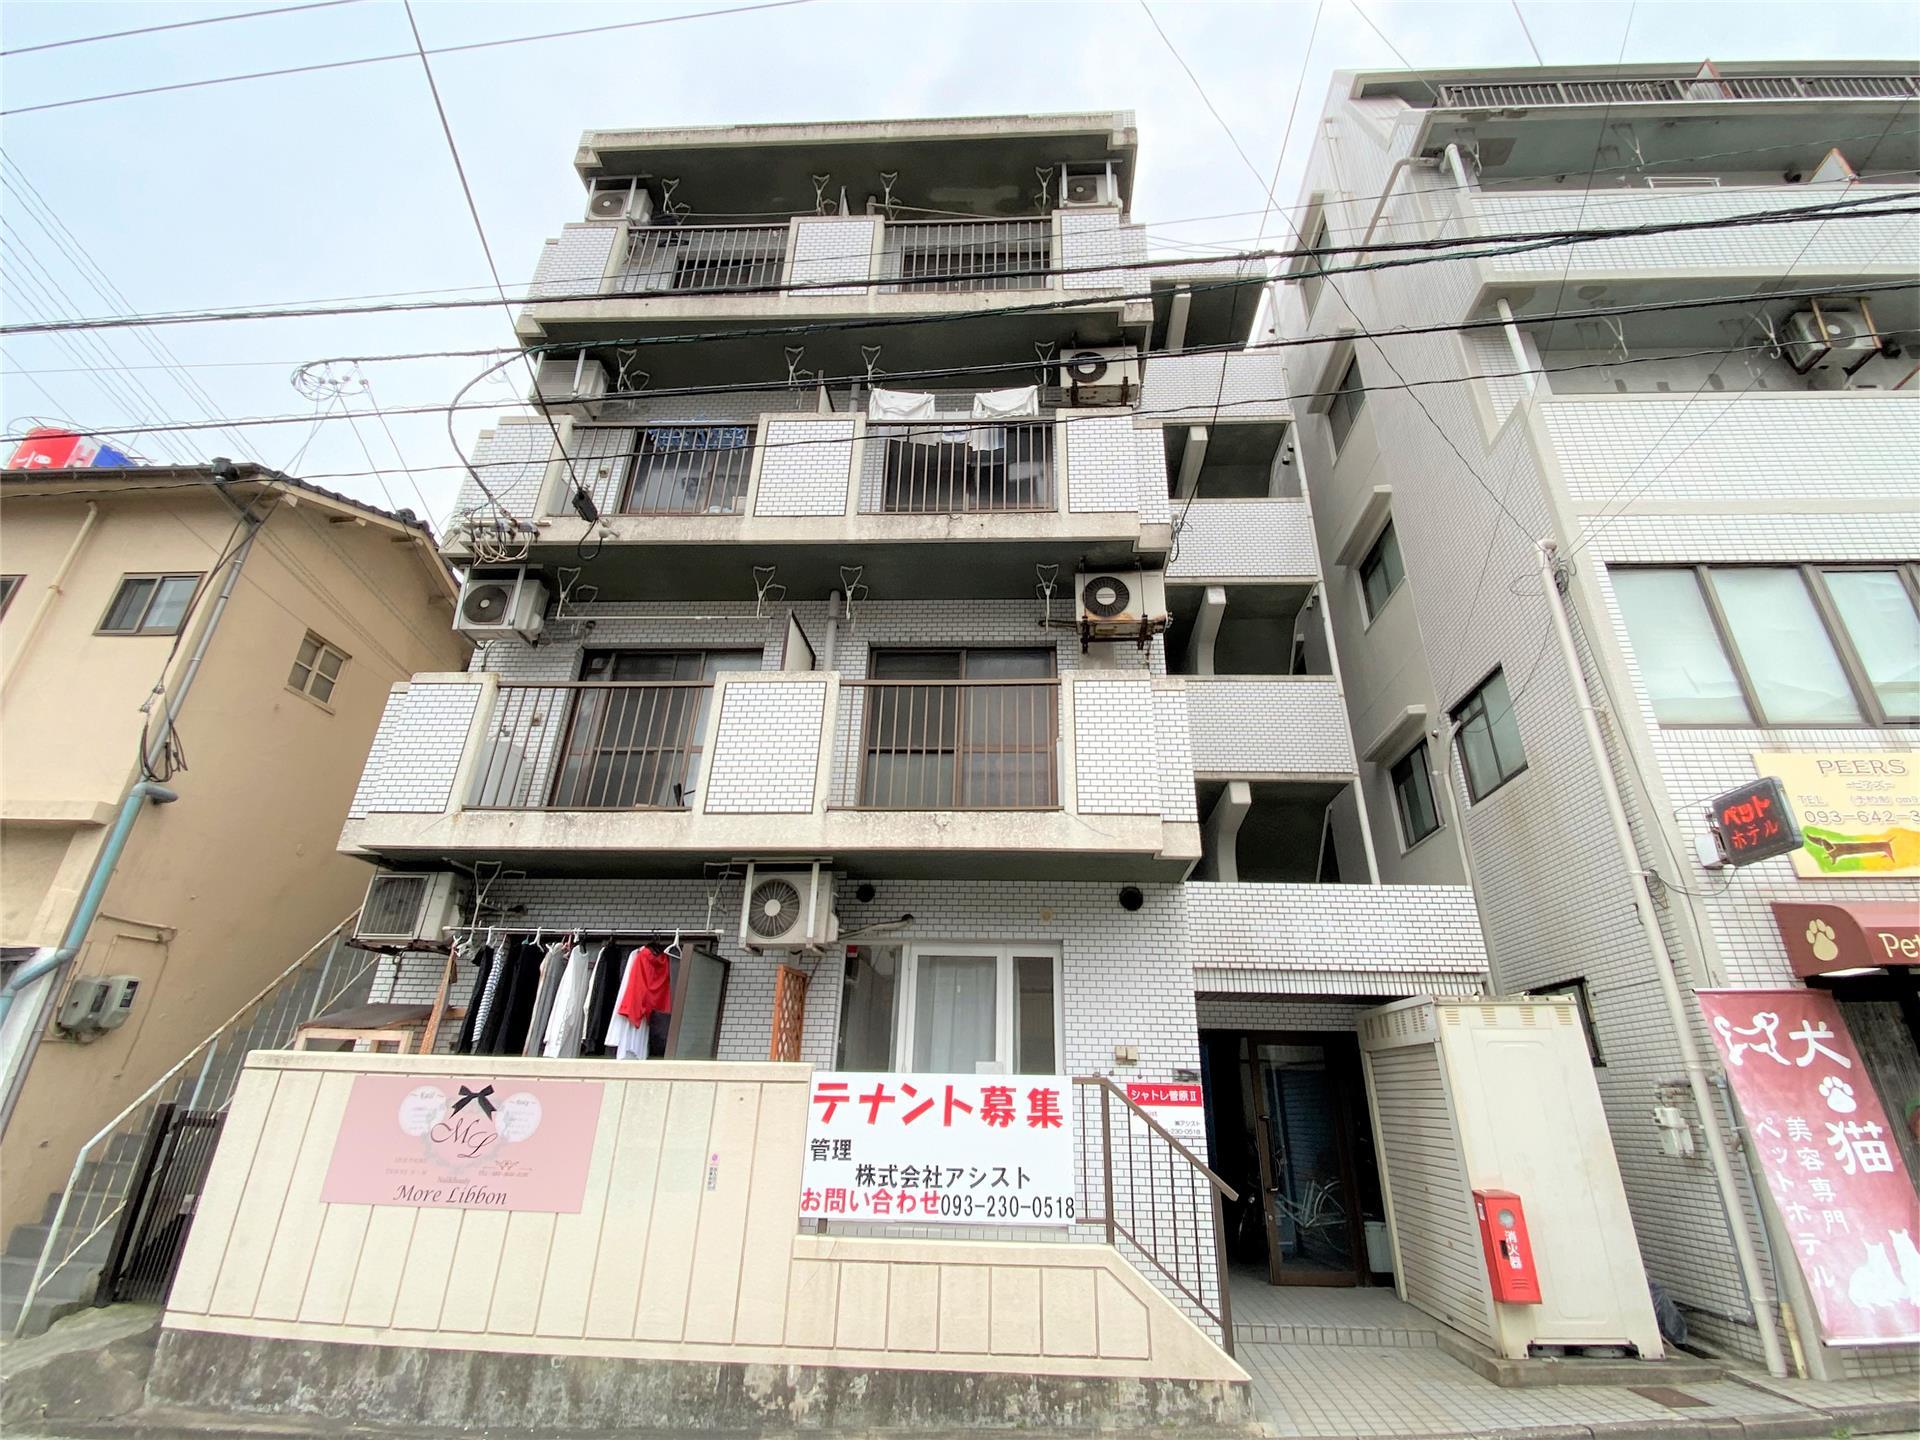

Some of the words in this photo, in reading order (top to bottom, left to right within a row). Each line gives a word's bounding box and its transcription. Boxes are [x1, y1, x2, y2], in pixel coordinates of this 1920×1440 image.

[1816, 759, 1907, 775] PEERS
[1722, 796, 1771, 825] ペット
[1731, 819, 1779, 849] ホテル
[1789, 1019, 1851, 1069] 犬
[813, 1082, 1064, 1129] テナント募集
[810, 1138, 852, 1162] 管理
[1825, 1120, 1895, 1176] 猫
[855, 1163, 1031, 1190] 株式会社アシスト
[1785, 1115, 1849, 1234] 美容専門
[393, 1184, 442, 1202] More
[446, 1186, 508, 1206] Libbon
[800, 1187, 941, 1215] お問い合わせ
[941, 1194, 1076, 1220] 093-230-0518
[1756, 1117, 1836, 1289] ペットホテル
